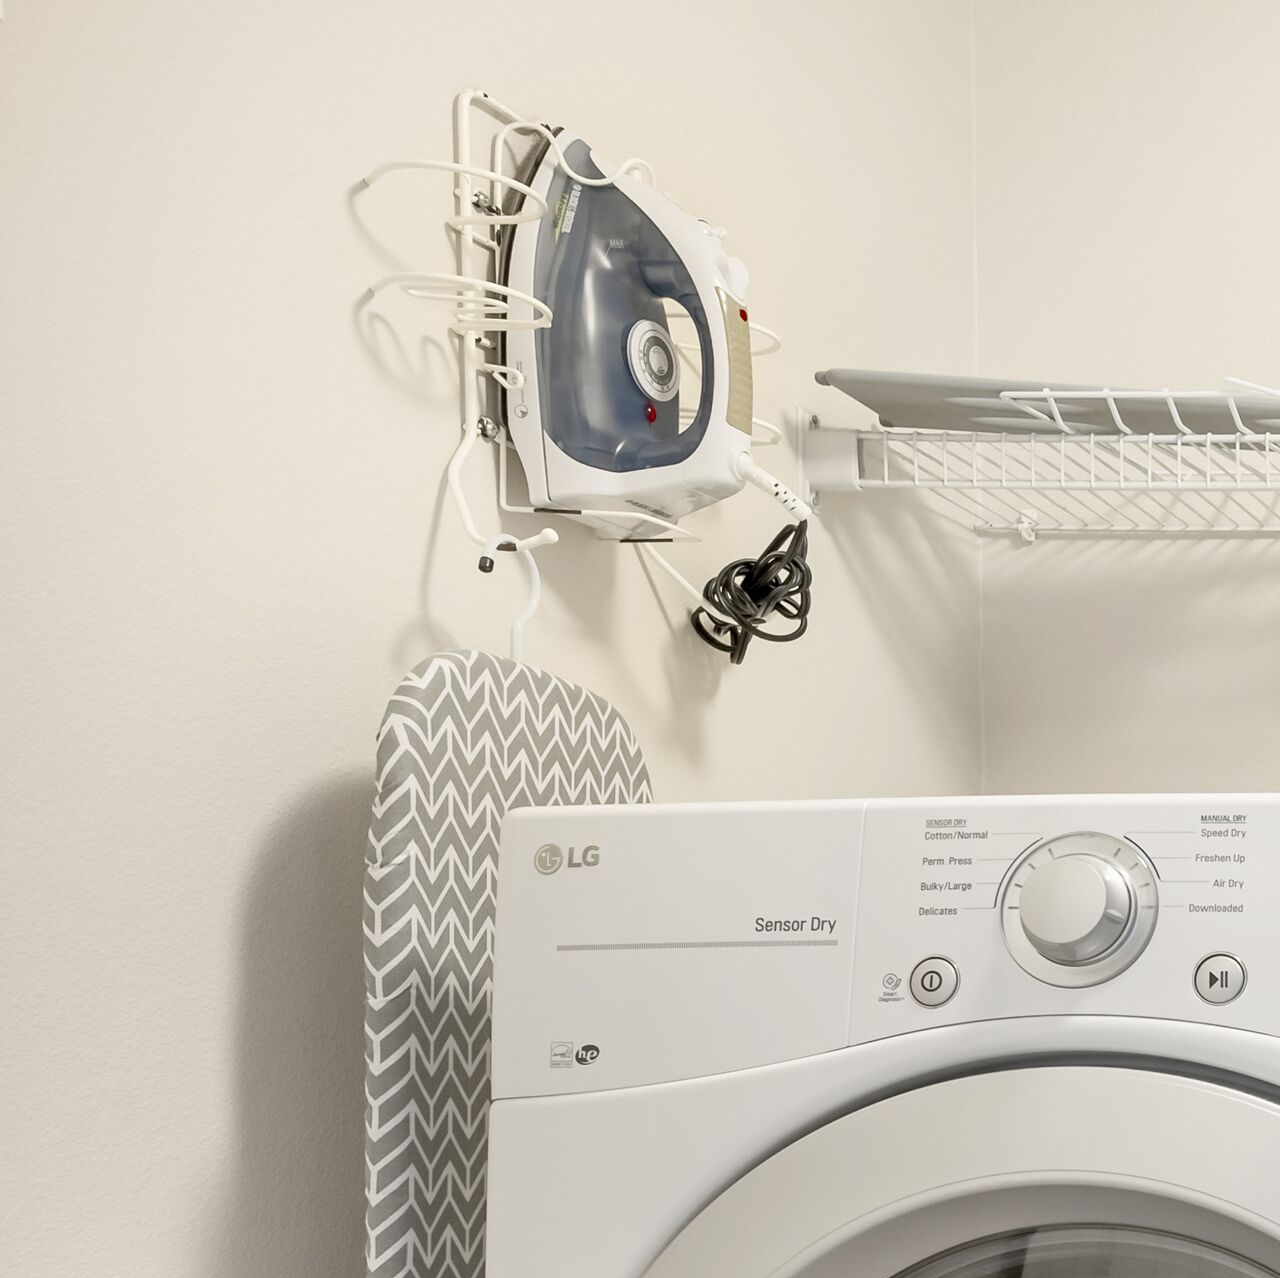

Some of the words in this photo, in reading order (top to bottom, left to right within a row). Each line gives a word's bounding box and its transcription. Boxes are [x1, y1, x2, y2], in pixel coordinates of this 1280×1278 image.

[925, 831, 988, 840] Cotton/Normal
[1201, 828, 1229, 838] Speed
[1231, 828, 1247, 838] Dry
[568, 845, 600, 868] LG
[949, 857, 972, 865] Press
[1195, 854, 1231, 862] Freshen
[1234, 854, 1245, 863] Up
[921, 882, 972, 891] Bulky/Large
[1229, 880, 1244, 889] Dry
[919, 907, 958, 916] Delicates
[1189, 904, 1243, 912] Downloaded
[755, 917, 807, 932] Sensor
[811, 917, 836, 934] Dry
